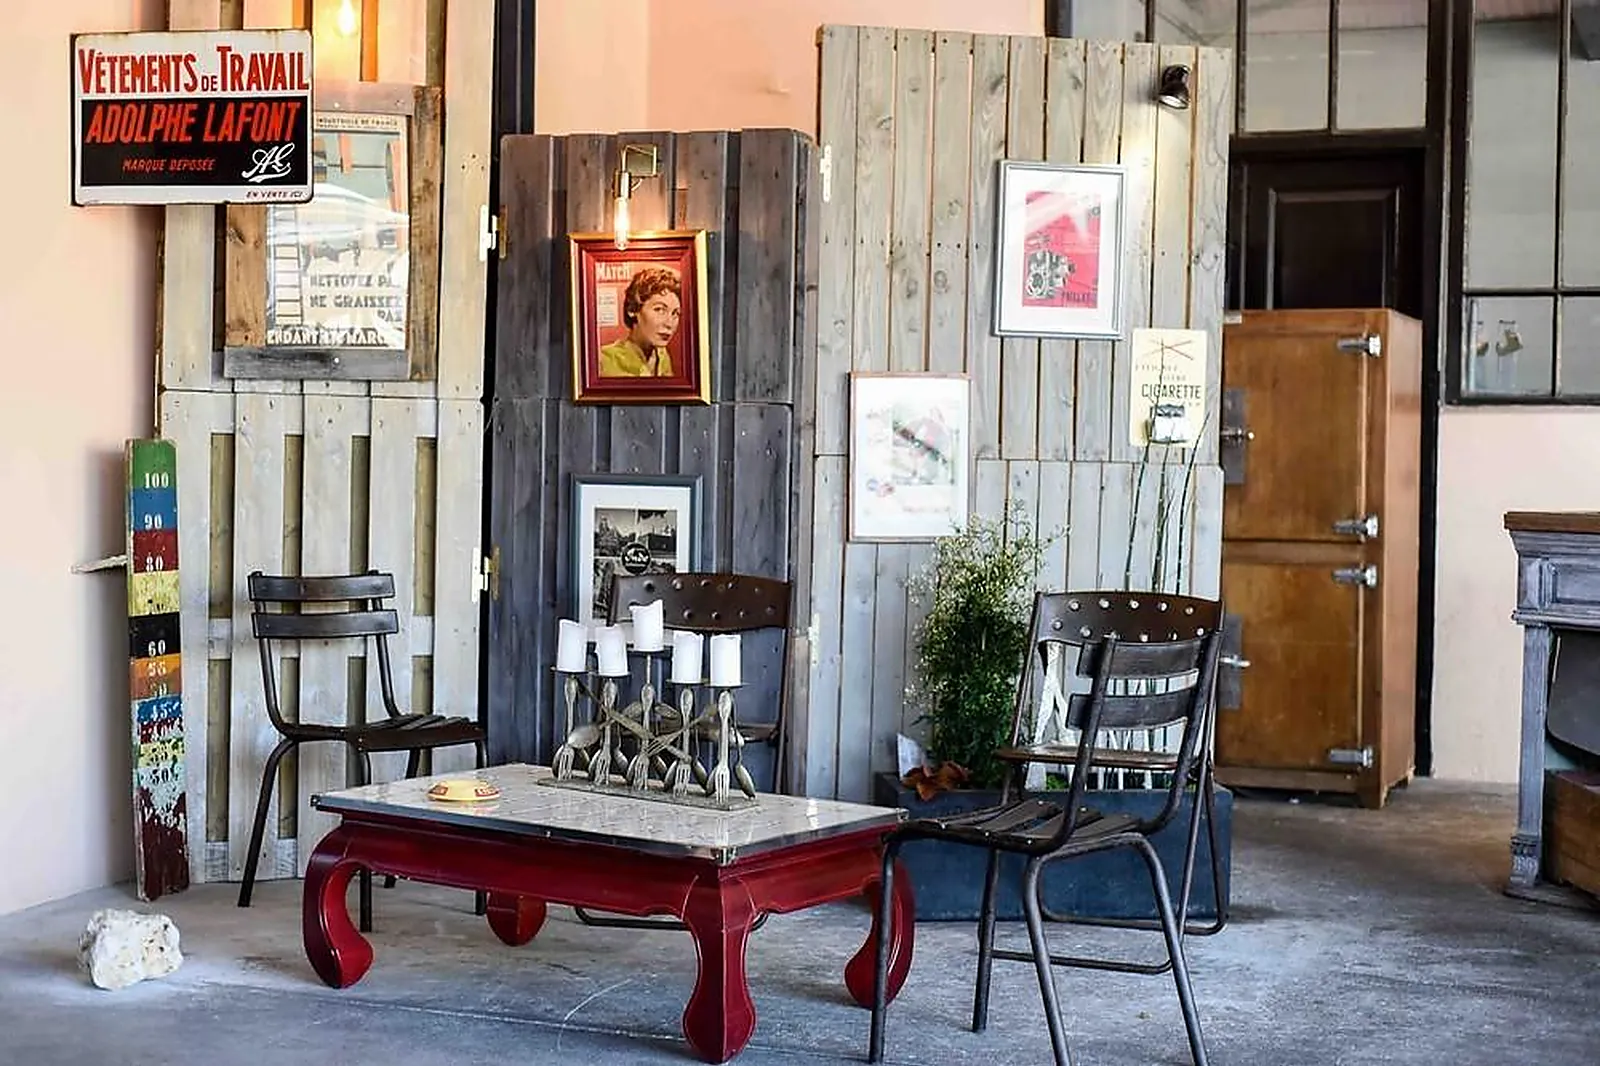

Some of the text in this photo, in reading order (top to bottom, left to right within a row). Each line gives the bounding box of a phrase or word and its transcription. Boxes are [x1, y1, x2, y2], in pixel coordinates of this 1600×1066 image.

[201, 75, 218, 91] DE
[217, 46, 309, 91] TRAVAIL
[85, 101, 300, 143] ADOLPHE LAFONT
[122, 159, 166, 172] MARQUE
[309, 294, 327, 308] NE
[1141, 383, 1202, 399] CIGARETTE
[144, 472, 169, 489] 100
[144, 513, 163, 531] 90
[148, 640, 166, 656] 60
